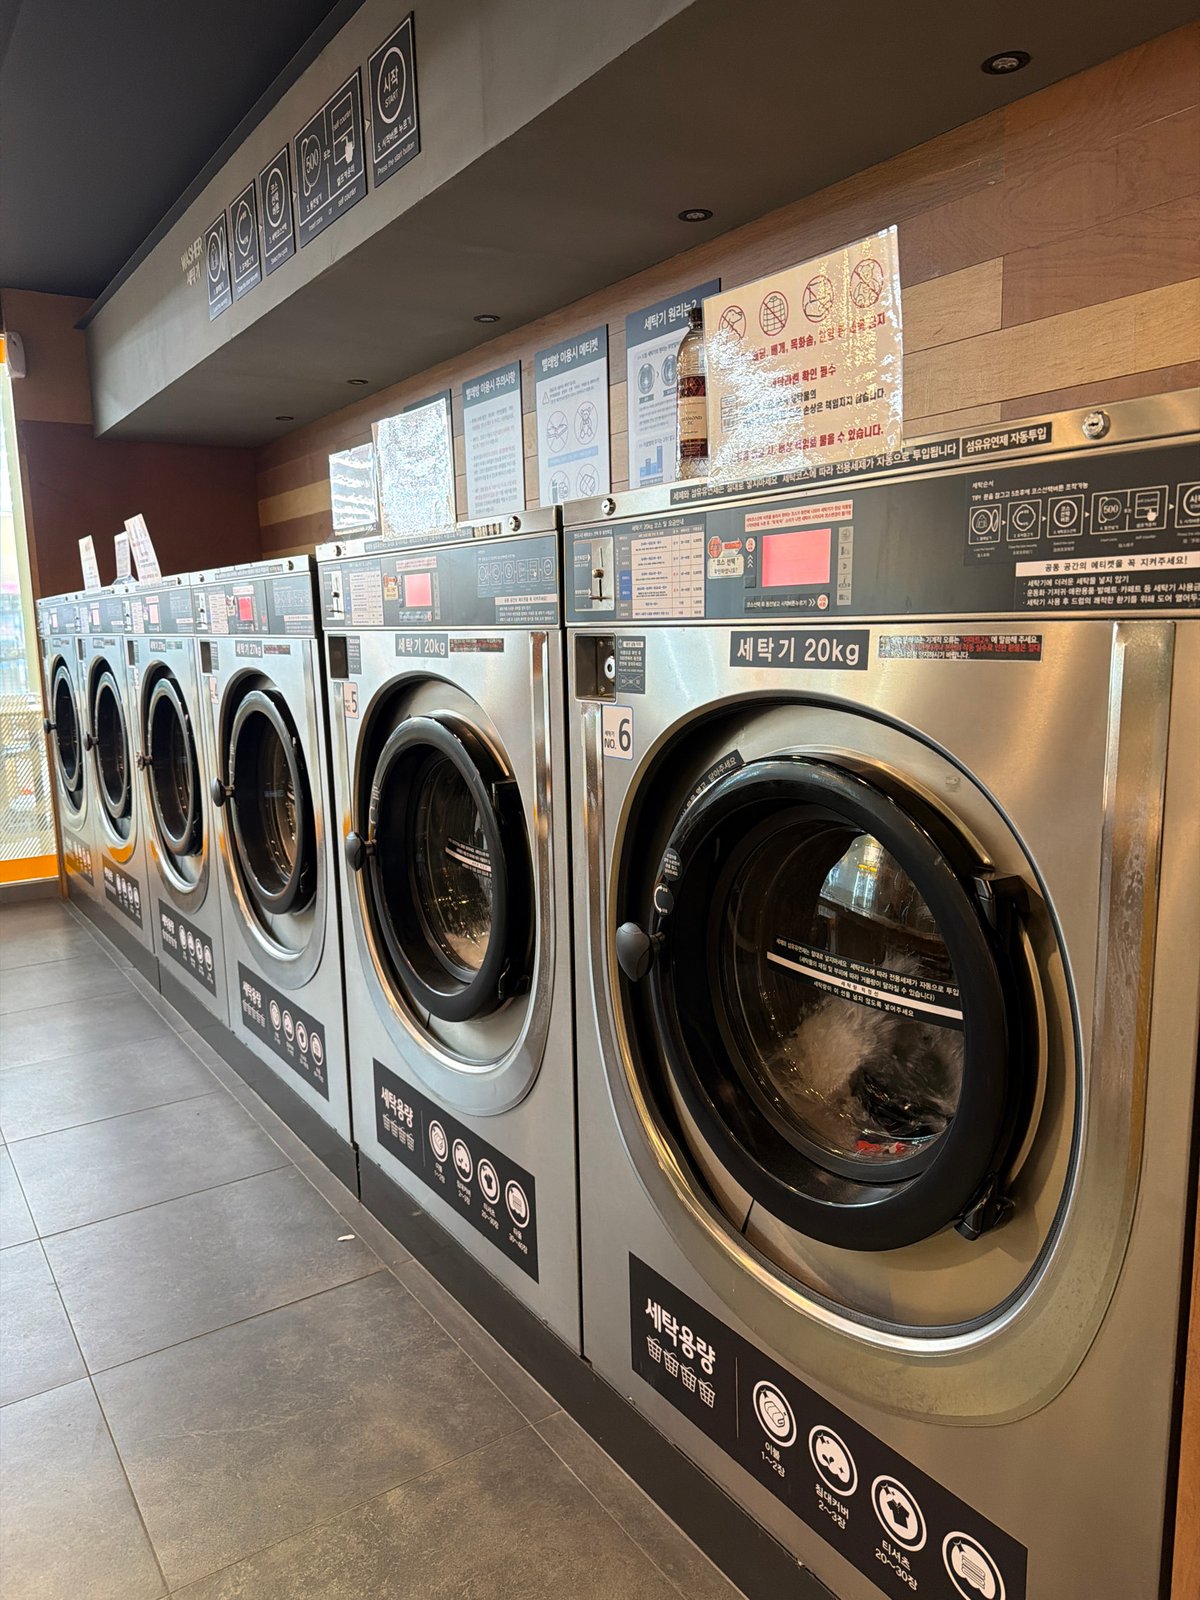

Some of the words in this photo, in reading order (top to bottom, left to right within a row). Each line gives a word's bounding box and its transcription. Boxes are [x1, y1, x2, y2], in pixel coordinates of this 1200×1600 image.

[383, 65, 398, 93] 시작
[384, 88, 398, 108] START
[306, 148, 318, 174] 500
[377, 165, 388, 176] Press
[401, 141, 415, 158] button
[180, 236, 203, 272] WASHER
[643, 310, 667, 330] 세탁기
[668, 299, 697, 324] 원리는?
[541, 354, 559, 372] 빨래방
[559, 348, 579, 365] 이용시
[579, 338, 598, 356] 에티켓
[790, 334, 816, 350] 목화솜,
[480, 378, 495, 395] 이용시
[495, 370, 516, 388] 주의사항
[802, 368, 817, 382] 확인
[820, 365, 836, 378] 필수
[803, 401, 822, 416] 손상은
[826, 396, 852, 411] 책임지지
[820, 433, 834, 447] 물을
[837, 431, 845, 443] 수
[848, 424, 884, 442] 있습니다.
[966, 434, 1008, 453] 섬유유연제
[1010, 427, 1046, 445] 자동투입
[746, 475, 778, 489] 넣지마세요
[782, 468, 817, 483] 세탁코스에
[818, 466, 833, 477] 따라
[836, 458, 874, 474] 전용세제가
[876, 451, 910, 467] 자동으로
[912, 443, 956, 461] 투입됩니다
[972, 480, 994, 489] 세탁순서
[1103, 505, 1119, 514] 500
[1064, 562, 1086, 571] 공간의
[1091, 559, 1123, 570] 에티켓을
[1128, 559, 1135, 567] 꼭
[1141, 556, 1187, 567] 지켜주세요!
[1028, 579, 1052, 587] 세탁기에
[1054, 578, 1073, 586] 더러운
[1099, 576, 1113, 584] 넣지
[1114, 575, 1129, 584] 않기
[1144, 584, 1151, 593] 등
[1154, 583, 1176, 592] 세탁기
[1026, 598, 1046, 606] 세탁기
[1047, 598, 1060, 606] 사용
[1071, 597, 1091, 605] 드럼의
[1141, 594, 1155, 604] 위해
[1157, 594, 1172, 603] 도어
[398, 638, 421, 654] 세탁기
[424, 639, 446, 656] 20kg
[737, 637, 794, 662] 세탁기
[804, 638, 860, 666] 20kg
[1019, 635, 1039, 644] 주세요.
[352, 691, 358, 713] 5
[604, 738, 617, 749] NO.
[618, 718, 631, 751] 6
[707, 757, 737, 782] 닫아주세요
[828, 965, 833, 973] 및
[849, 973, 859, 981] 따라
[882, 982, 900, 992] 달라질
[909, 989, 936, 1001] 있습니다)
[850, 963, 875, 976] 세탁코스에
[876, 970, 888, 979] 따라
[889, 973, 918, 987] 전용세제가
[920, 981, 944, 993] 자동으로
[946, 987, 959, 996] 투입
[840, 990, 850, 998] 선을
[865, 998, 881, 1008] 않도록
[884, 1003, 914, 1017] 넣어주세요
[381, 1086, 413, 1128] 세탁용량
[646, 1298, 715, 1375] 세탁용량
[761, 1451, 785, 1478] 1~2장
[765, 1442, 780, 1461] 이불
[815, 1484, 849, 1520] 침대커버
[818, 1500, 846, 1530] 2~3장
[882, 1540, 911, 1572] 티셔츠
[875, 1548, 917, 1591] 20~30장
